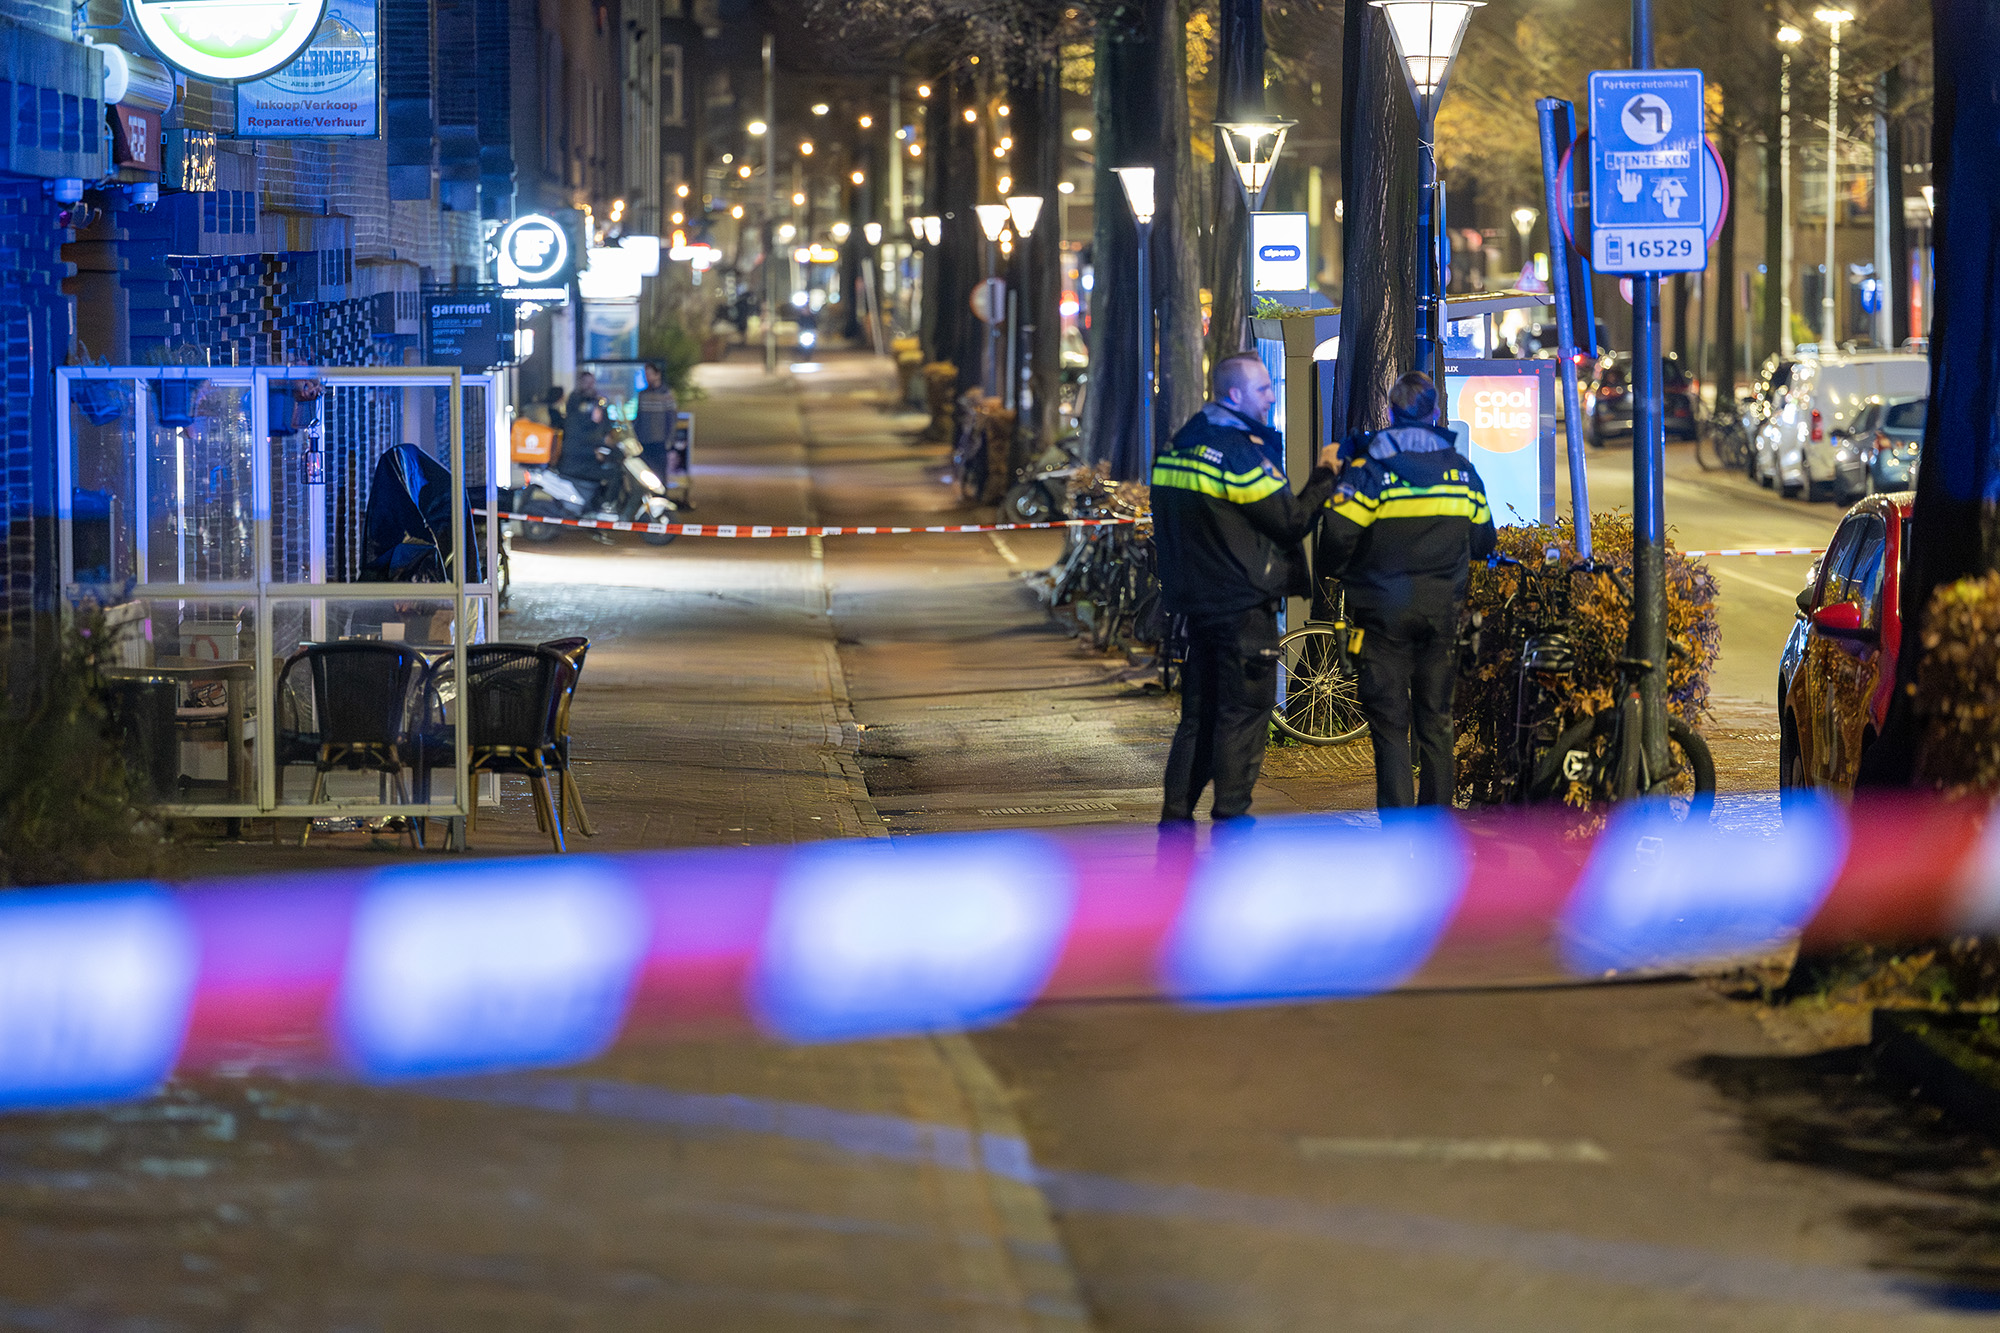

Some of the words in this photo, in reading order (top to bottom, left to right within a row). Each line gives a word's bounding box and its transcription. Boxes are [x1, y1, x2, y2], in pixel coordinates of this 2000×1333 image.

[1602, 80, 1689, 90] Parkeerautomaat
[256, 100, 358, 112] Inkoop/Verkoop
[247, 117, 367, 128] Reparatie/Verhuur
[1627, 239, 1692, 258] 16529
[431, 302, 492, 318] garment
[1474, 387, 1532, 409] cool
[1474, 407, 1532, 429] blue
